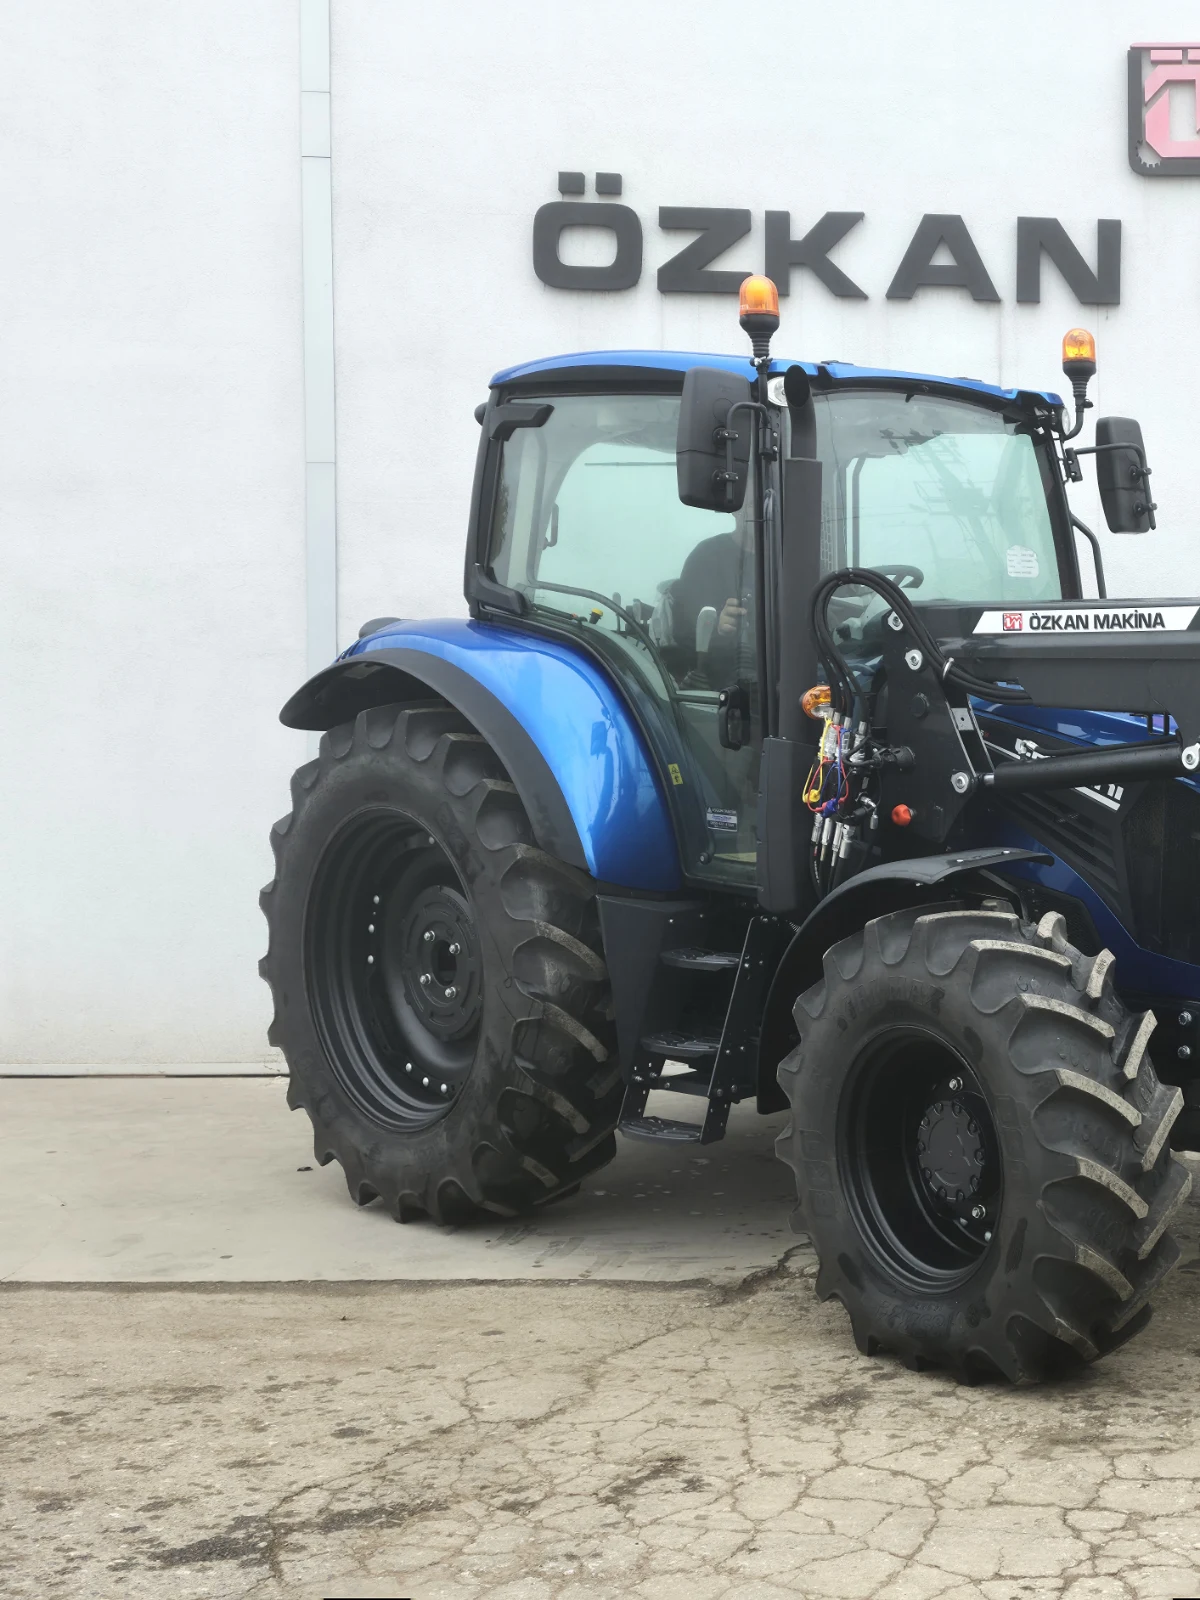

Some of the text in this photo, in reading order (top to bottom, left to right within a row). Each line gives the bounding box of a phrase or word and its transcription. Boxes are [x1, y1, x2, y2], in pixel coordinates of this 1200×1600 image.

[532, 171, 1122, 305] ÖZKAN
[1028, 609, 1166, 631] ÖZKAN MAKİNA
